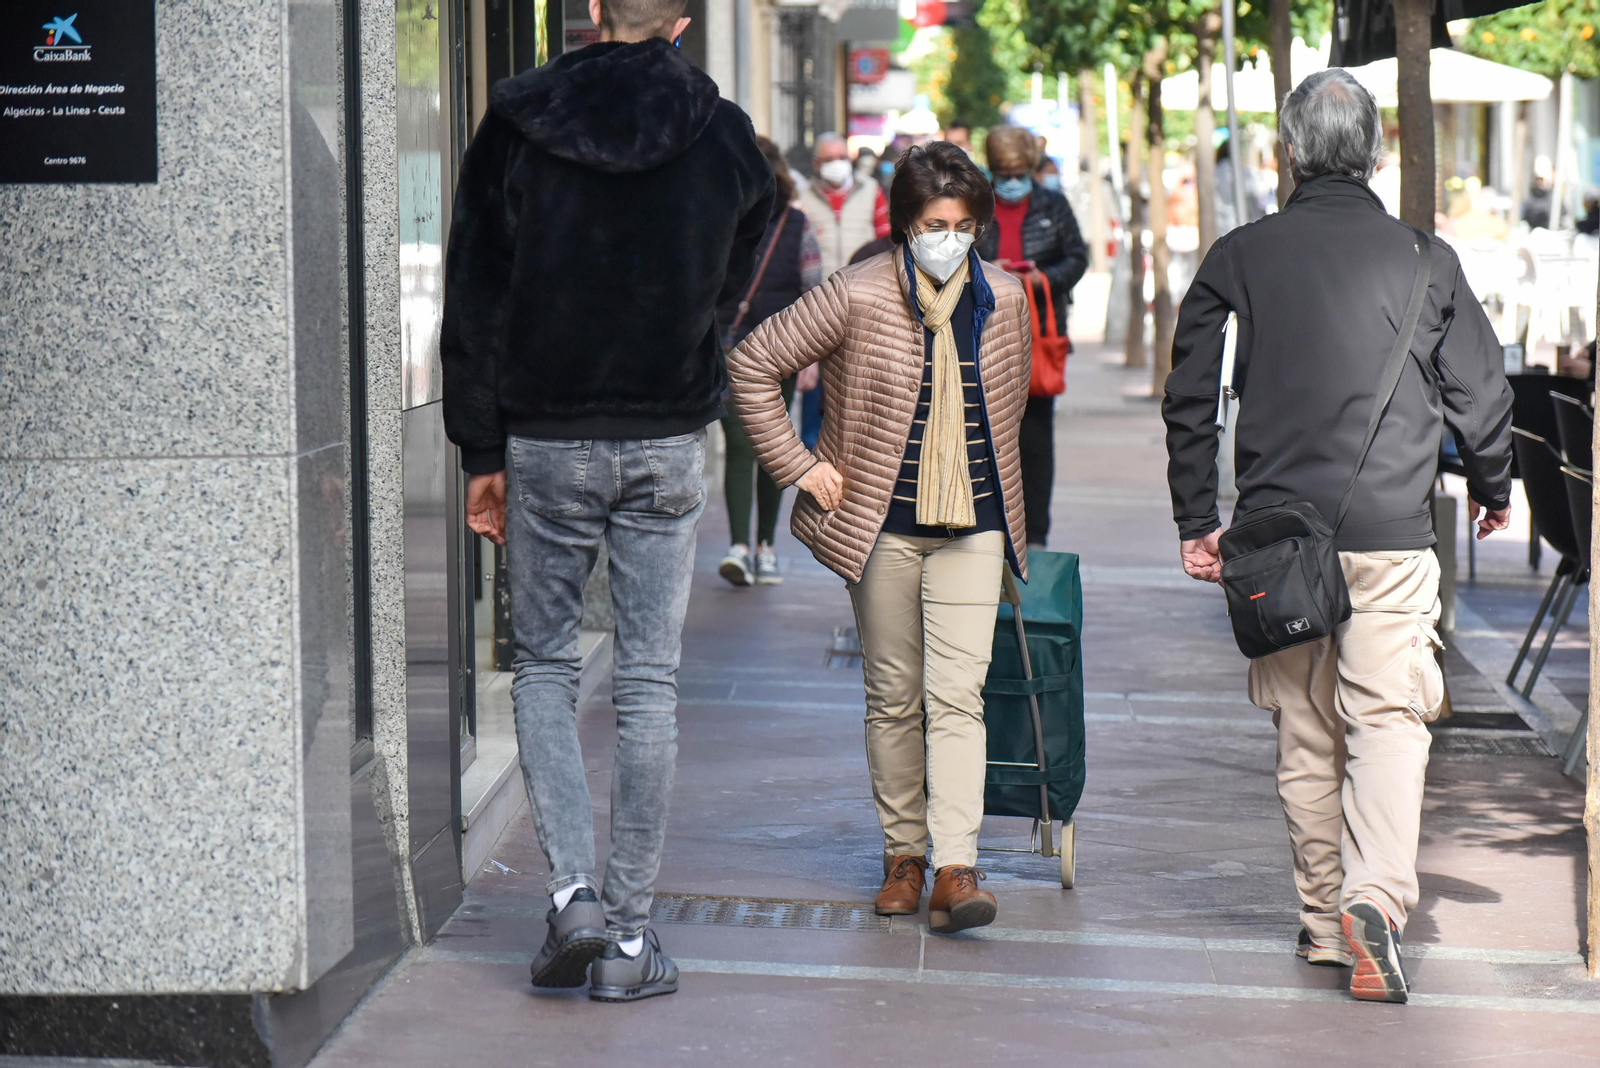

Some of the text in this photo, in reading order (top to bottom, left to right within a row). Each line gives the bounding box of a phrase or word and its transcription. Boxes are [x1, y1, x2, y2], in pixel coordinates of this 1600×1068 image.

[33, 49, 92, 62] CaixaBank
[0, 82, 125, 95] Dirección Área de Negocio
[3, 106, 45, 118] Algeciras
[52, 106, 64, 116] La
[98, 105, 126, 115] Ceuta
[43, 156, 87, 165] Centro 9676
